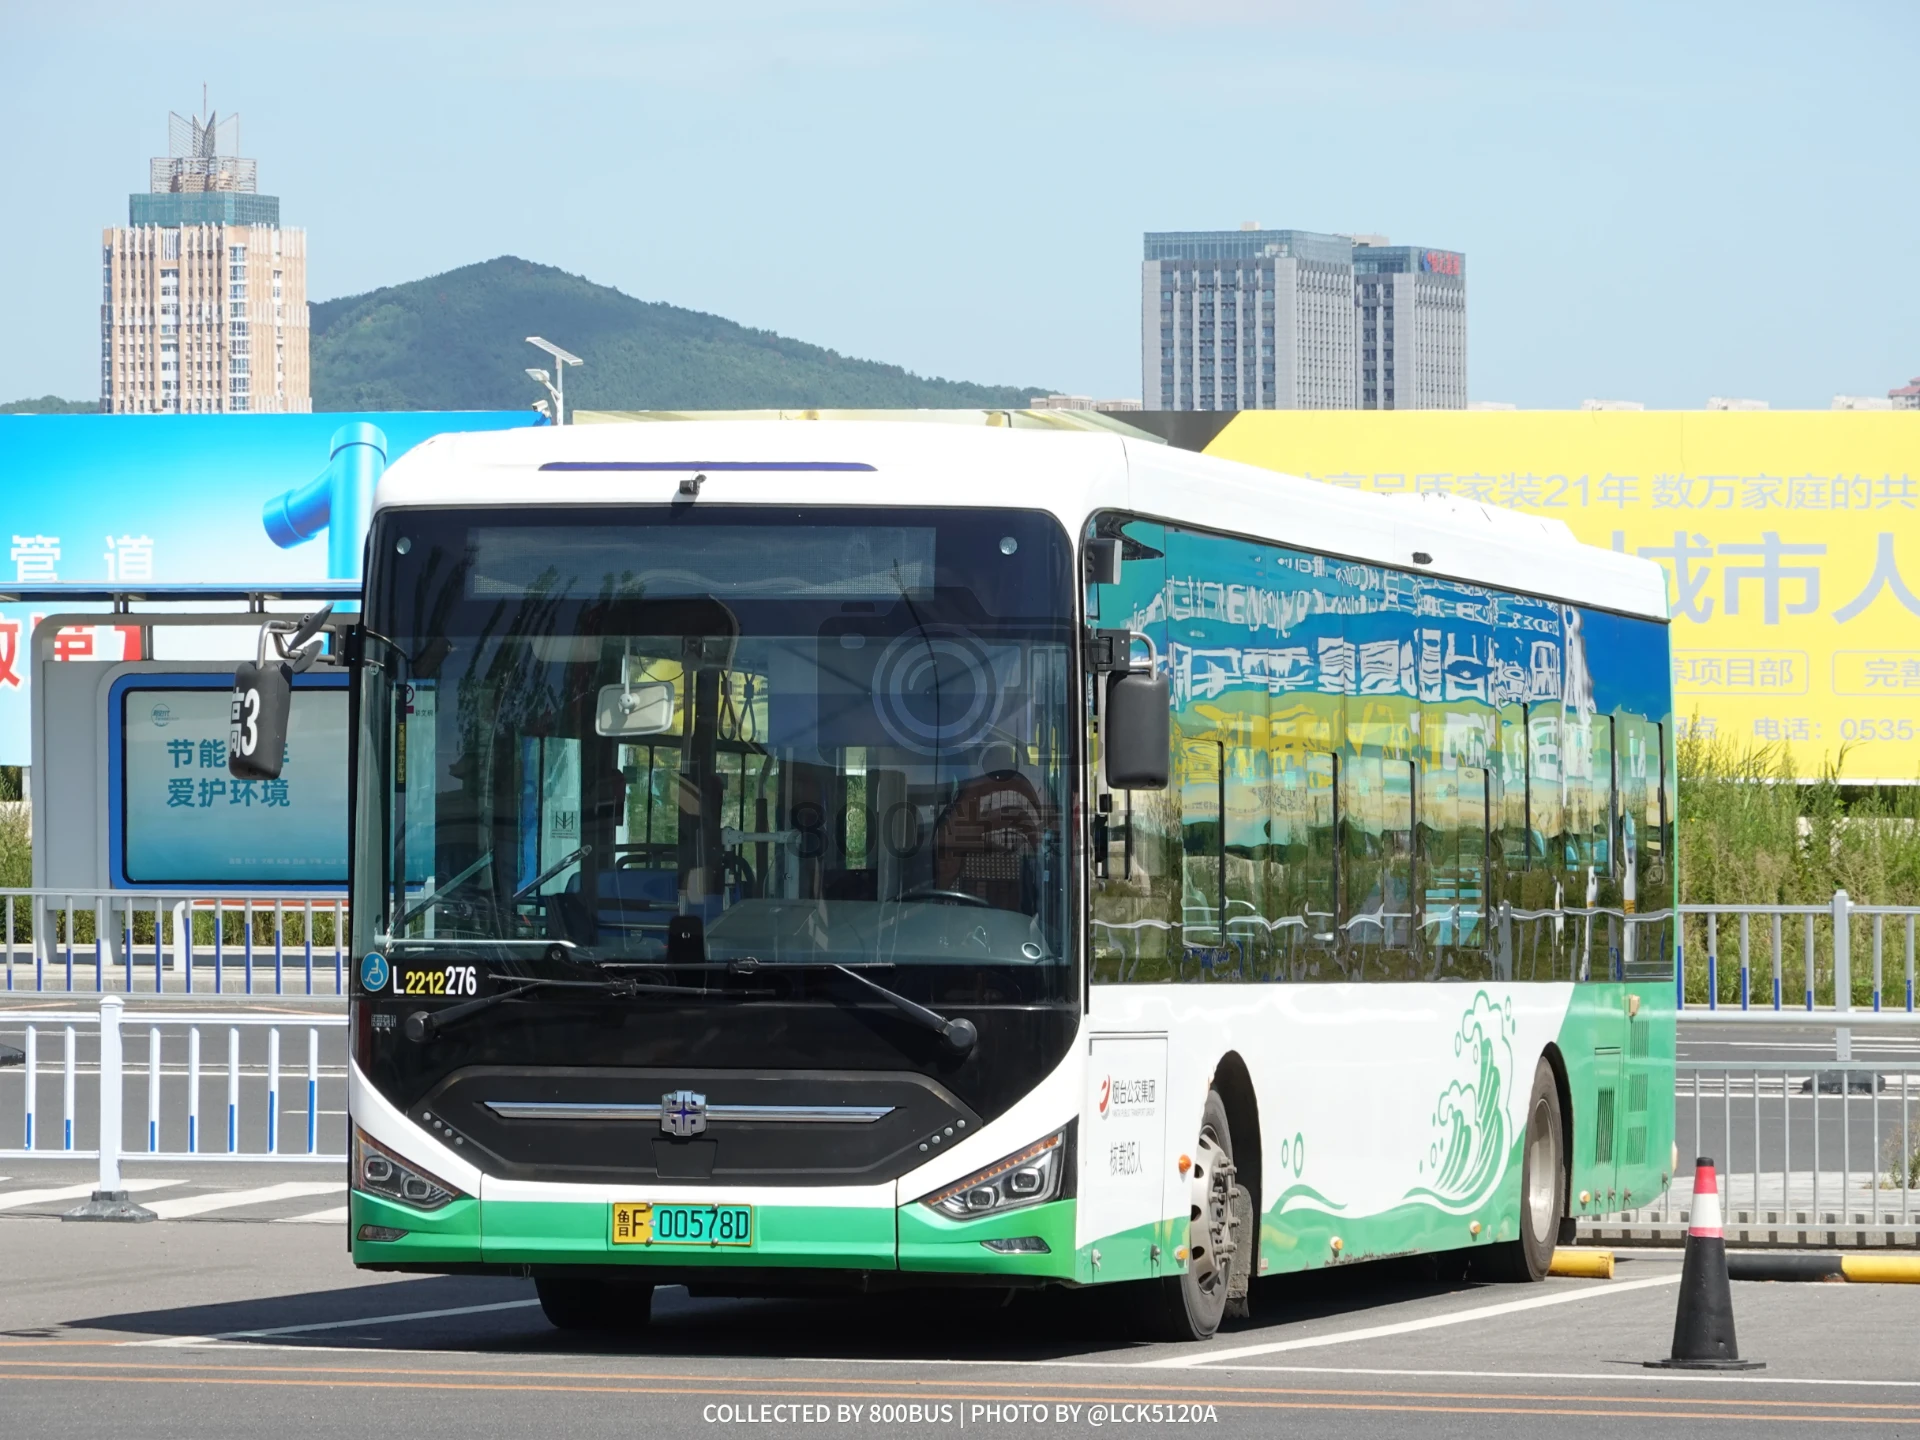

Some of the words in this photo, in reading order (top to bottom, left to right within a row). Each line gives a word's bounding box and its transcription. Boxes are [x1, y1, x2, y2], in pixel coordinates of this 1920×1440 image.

[1304, 472, 1640, 509] 质家装21年
[1651, 472, 1919, 510] 数万家庭的共
[166, 777, 290, 808] 爱护环境
[1112, 1080, 1156, 1104] 烟台公交集团
[617, 1208, 648, 1238] 鲁F
[659, 1209, 750, 1240] 00578D
